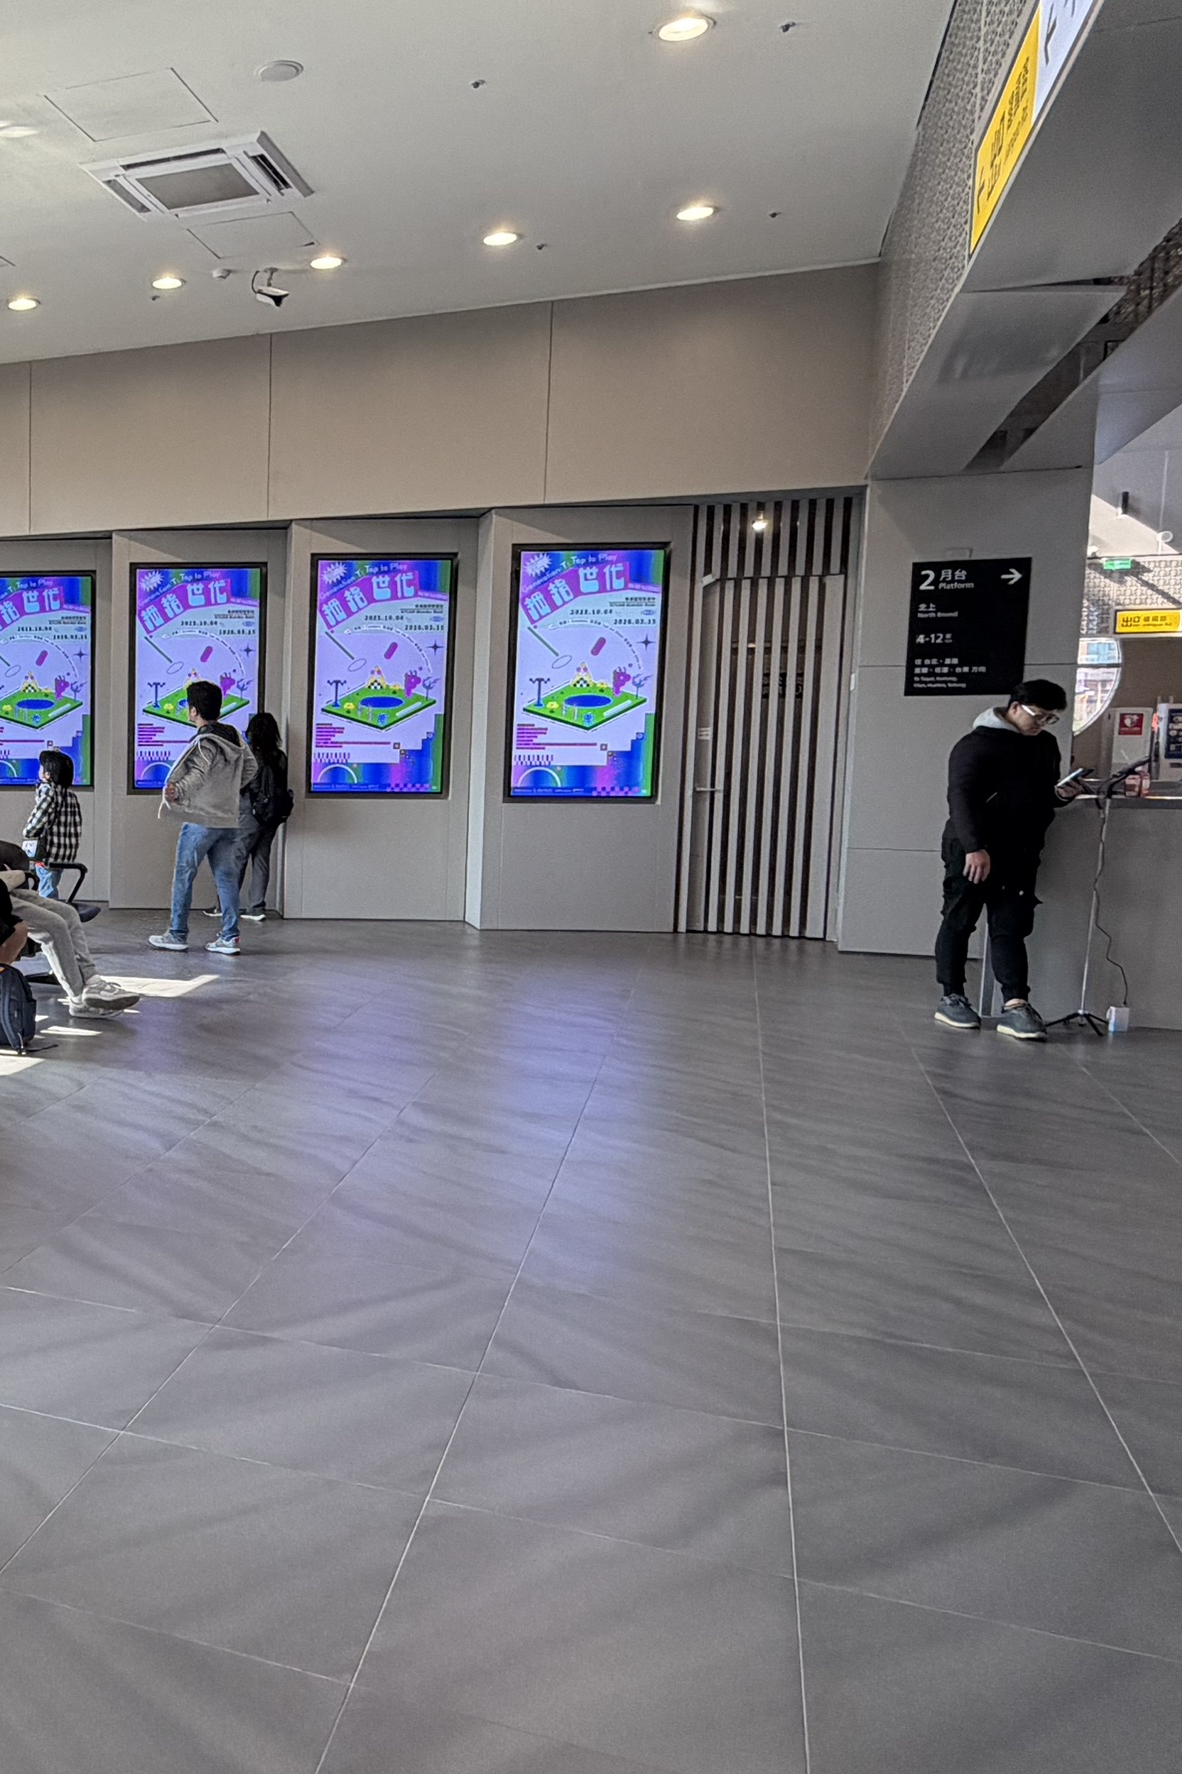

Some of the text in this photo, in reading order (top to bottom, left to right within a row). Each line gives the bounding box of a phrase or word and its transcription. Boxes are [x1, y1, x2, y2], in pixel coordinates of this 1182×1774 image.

[919, 568, 967, 590] 2 月台
[938, 582, 975, 590] Platform
